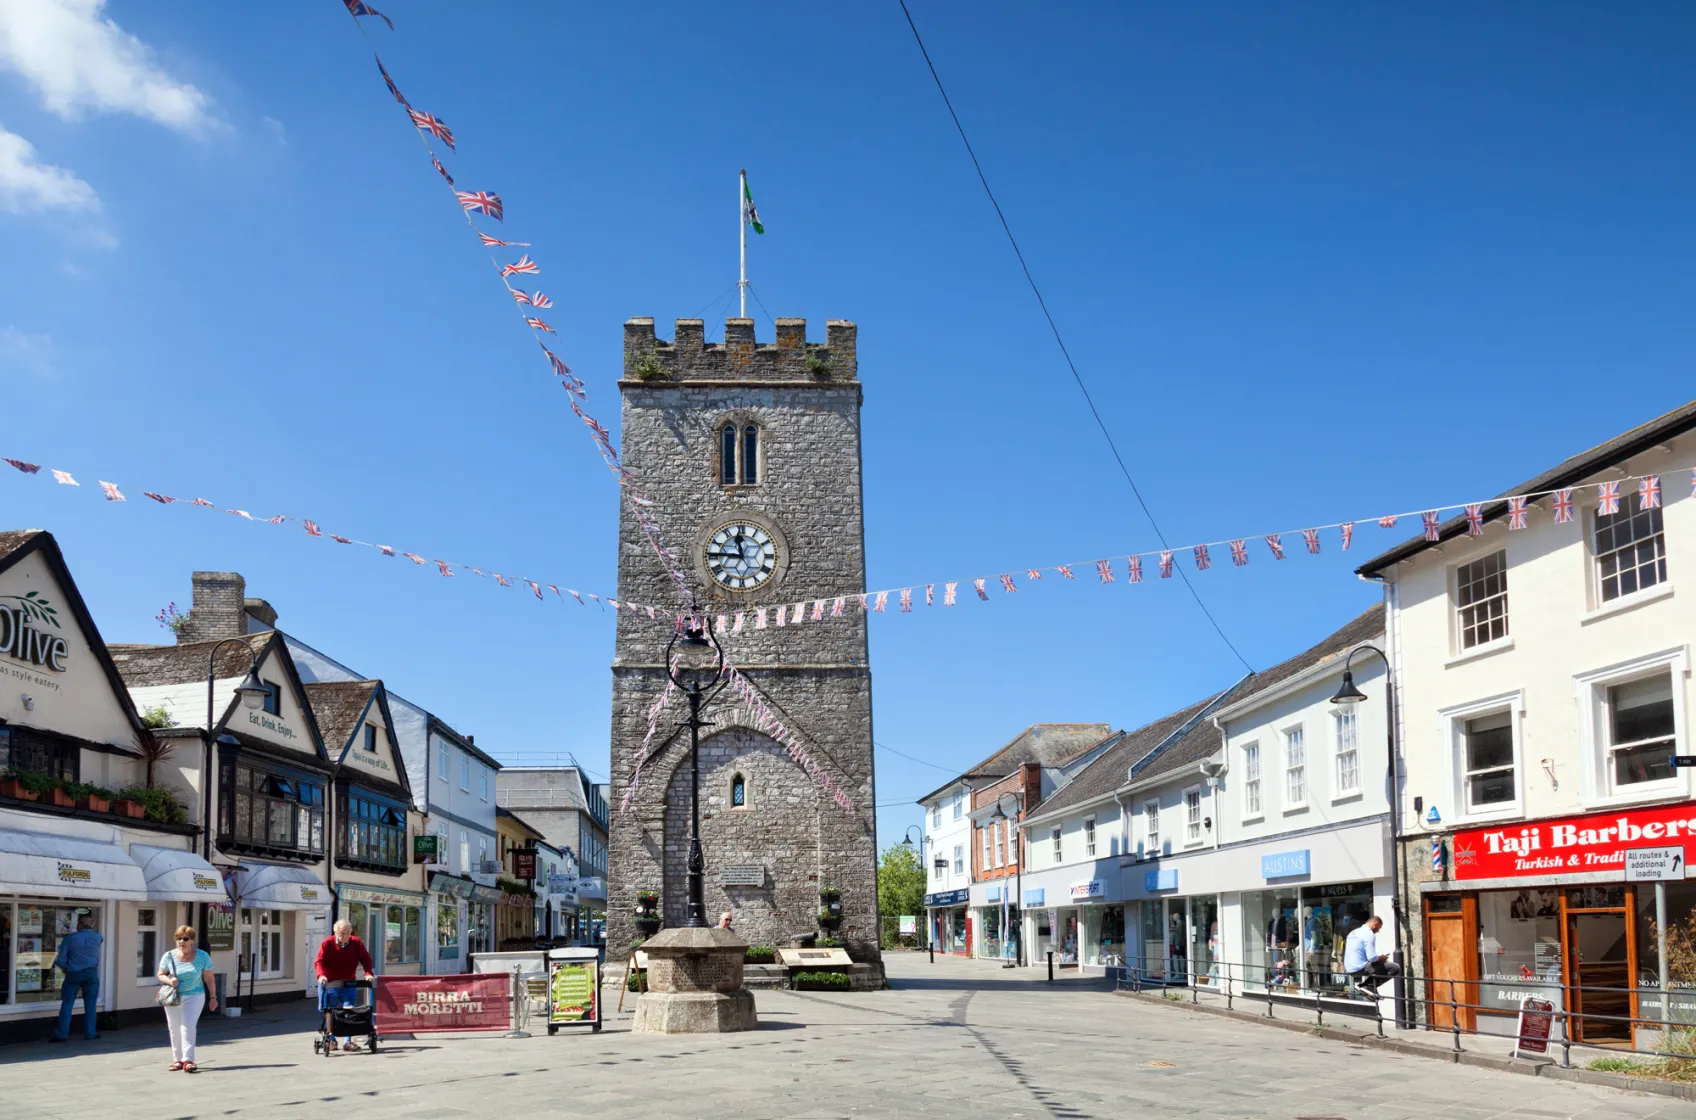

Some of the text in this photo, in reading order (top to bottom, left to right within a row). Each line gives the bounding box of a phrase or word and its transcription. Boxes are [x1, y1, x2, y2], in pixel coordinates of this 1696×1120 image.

[0, 604, 69, 673] Olive
[12, 670, 32, 681] style
[34, 677, 60, 692] eatery
[249, 711, 261, 728] Eat,
[261, 716, 278, 734] Drink,
[1484, 817, 1696, 857] Taji Barbers
[1264, 855, 1304, 873] AUSTINS
[1515, 850, 1625, 870] Turkish & Tradi
[1628, 850, 1669, 860] All routes &
[1631, 860, 1666, 869] additional
[1635, 869, 1662, 878] loading
[208, 906, 233, 930] Olive
[1496, 974, 1526, 982] VOUCHERS
[416, 991, 471, 1003] BIRRA
[404, 1002, 483, 1015] MORETTI
